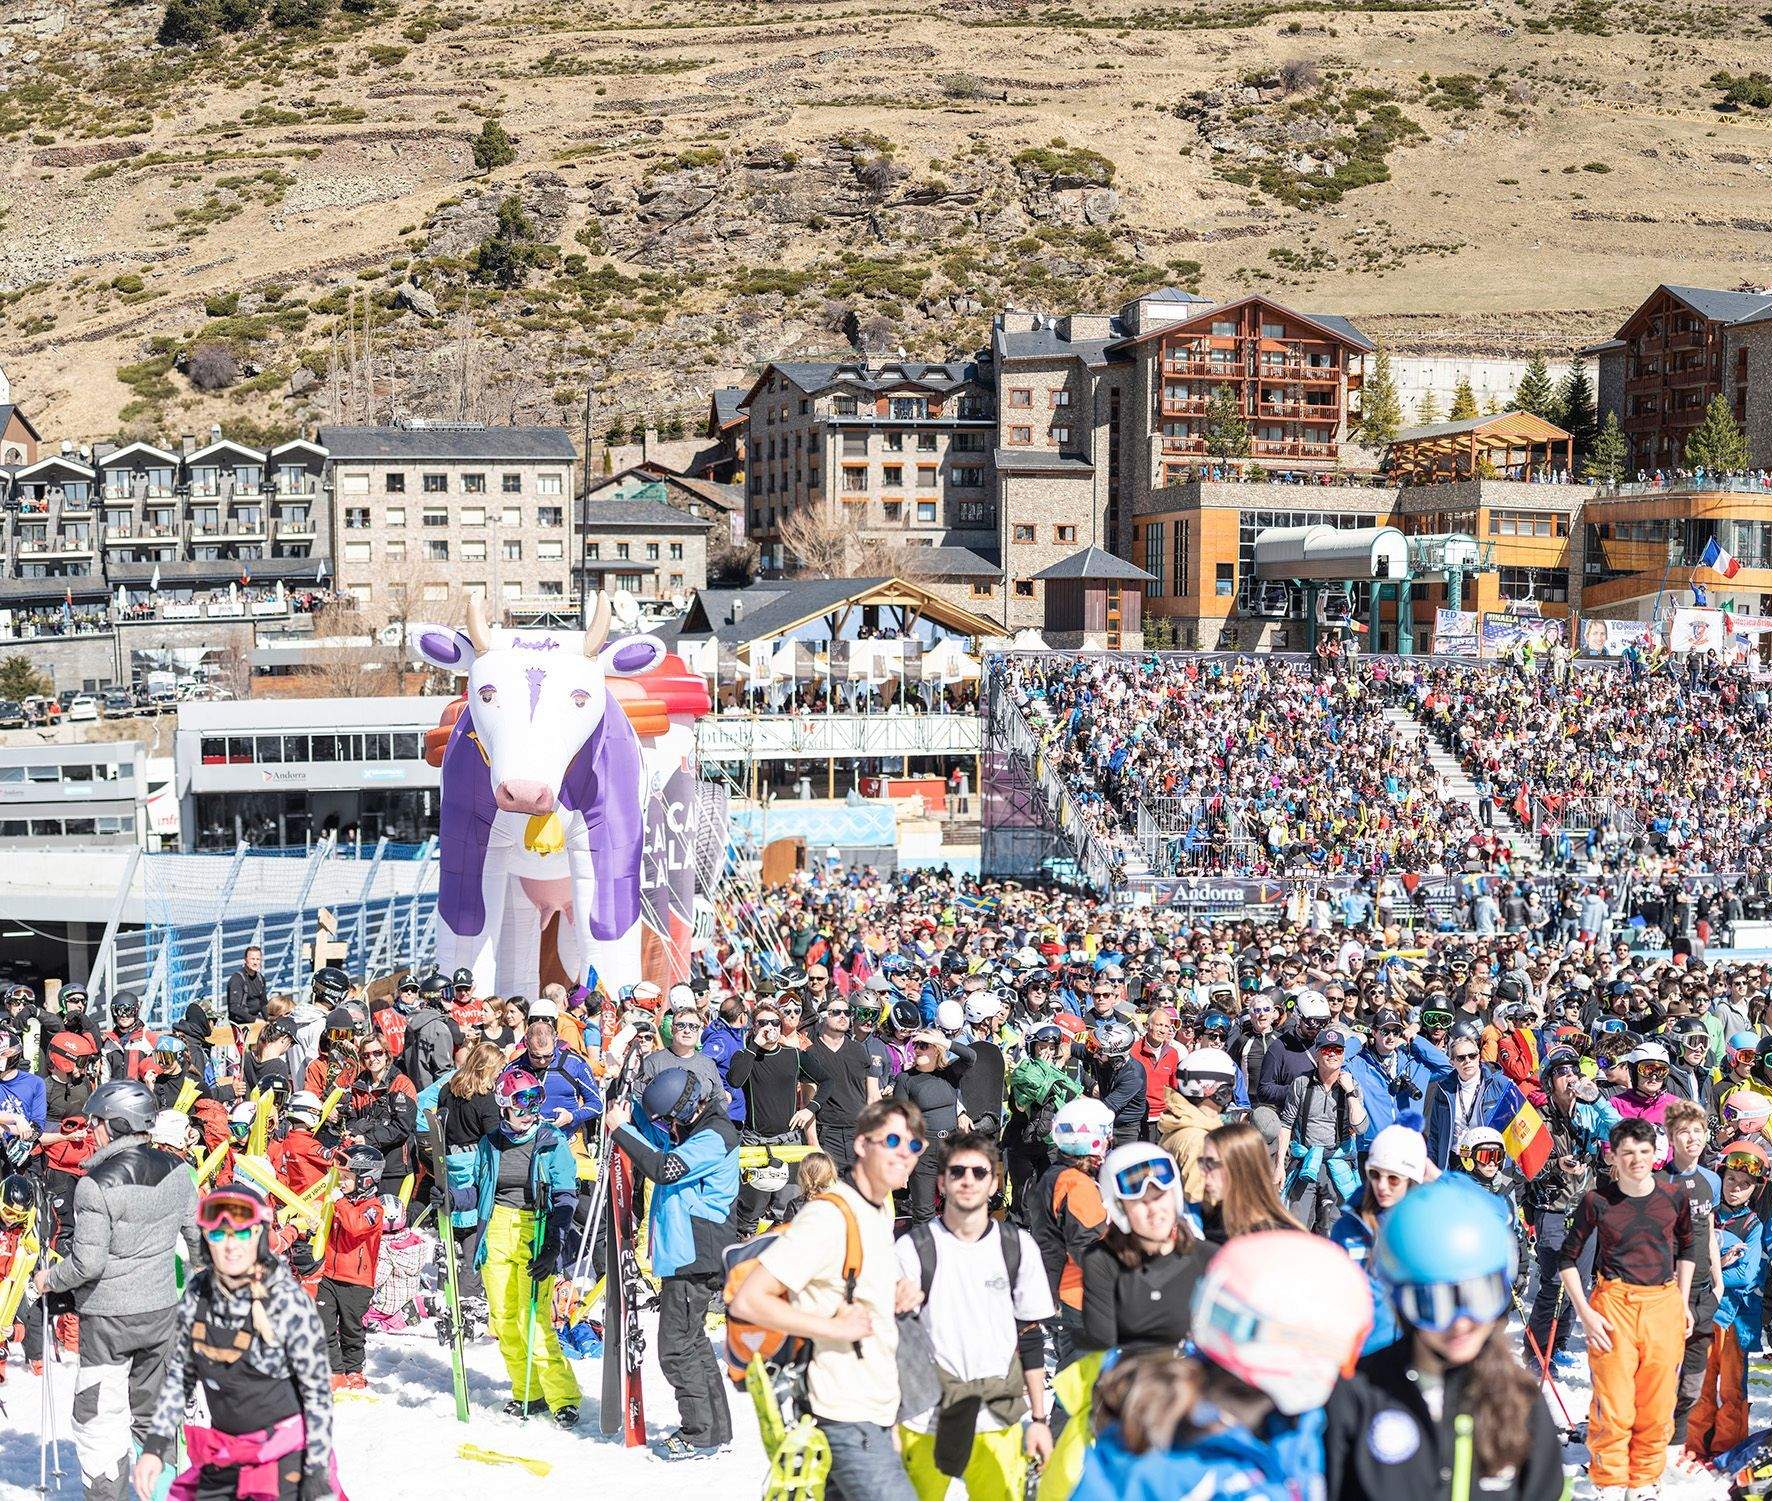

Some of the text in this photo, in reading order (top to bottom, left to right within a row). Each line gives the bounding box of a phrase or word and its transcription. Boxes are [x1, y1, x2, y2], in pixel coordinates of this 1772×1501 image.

[1440, 610, 1457, 619] TED
[273, 771, 307, 780] Andorra
[1172, 883, 1245, 901] Andorra
[613, 1152, 623, 1190] ATOMIC
